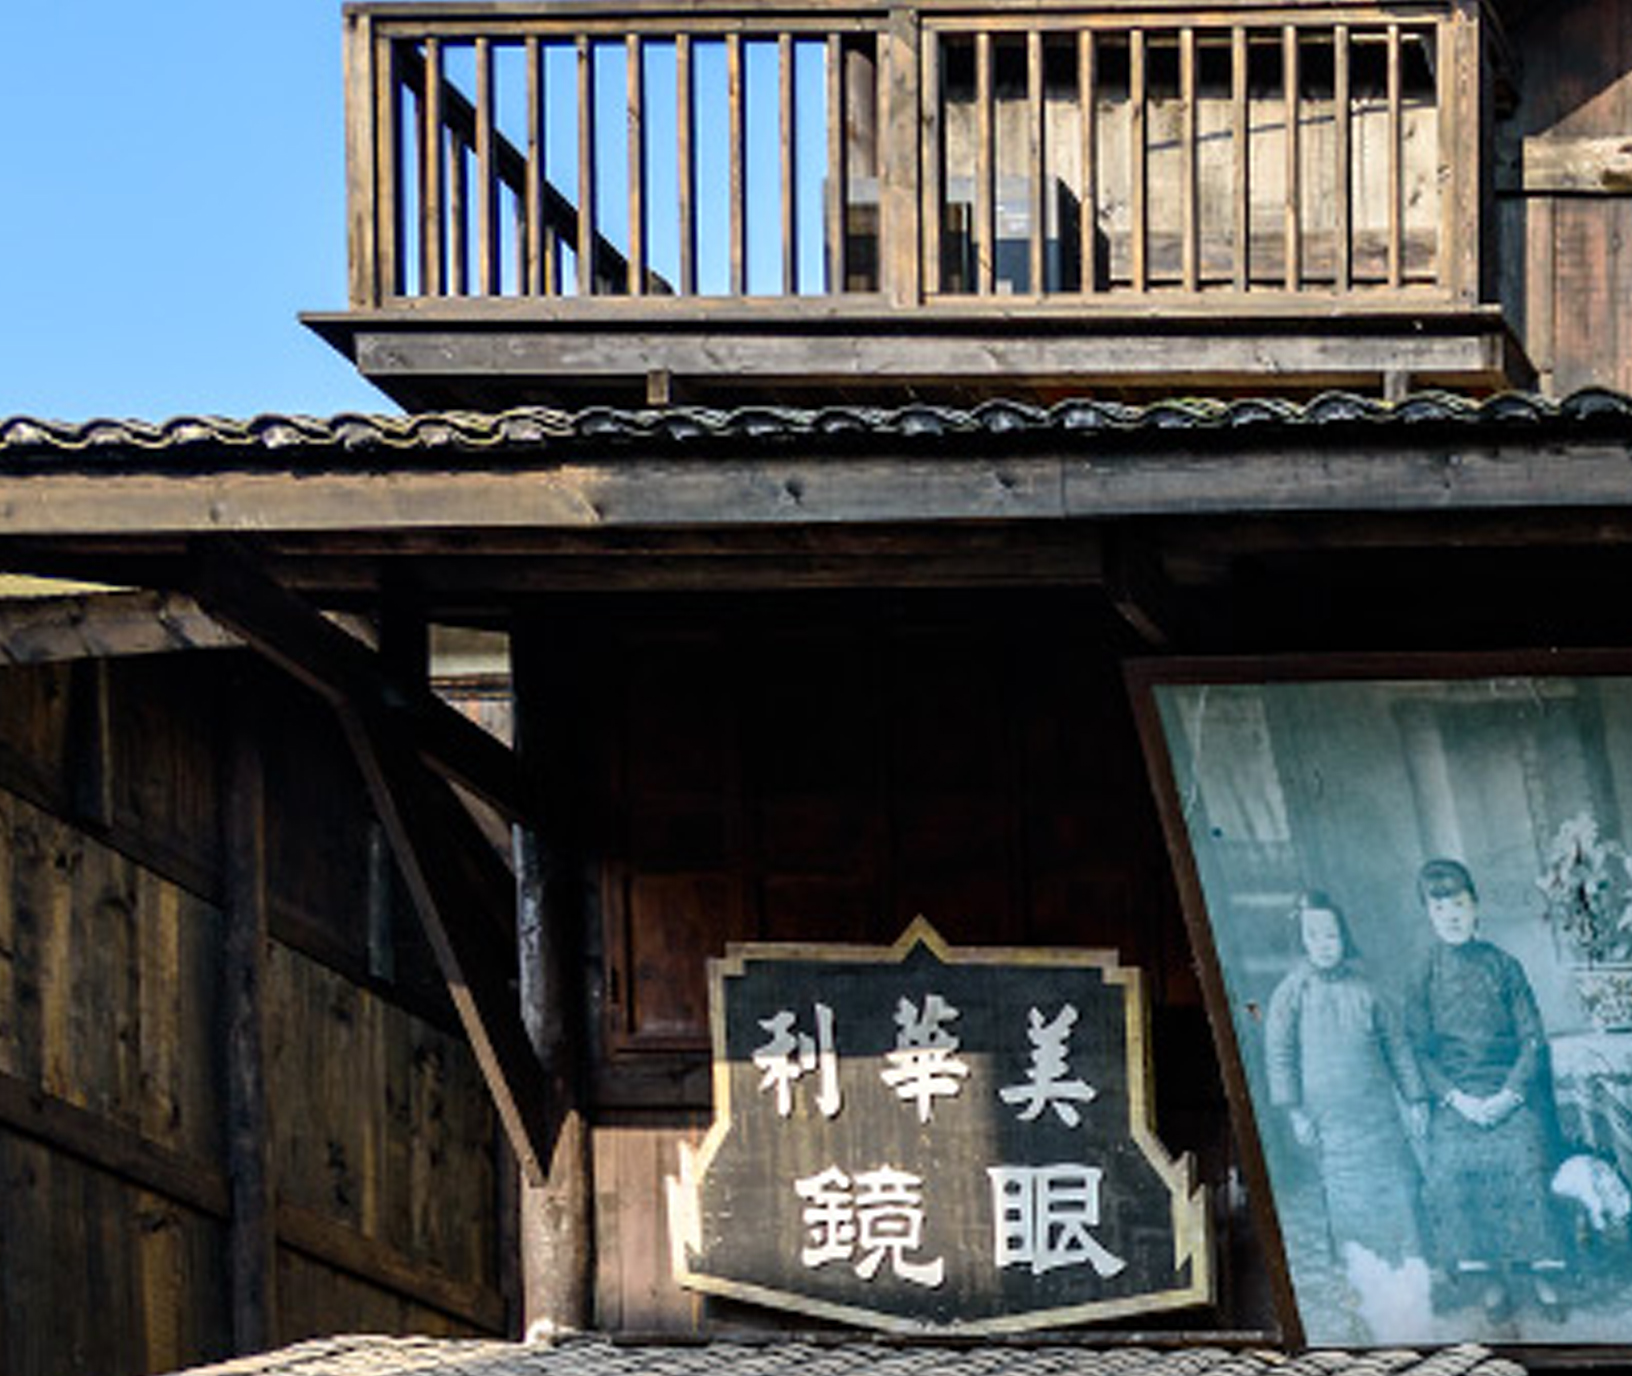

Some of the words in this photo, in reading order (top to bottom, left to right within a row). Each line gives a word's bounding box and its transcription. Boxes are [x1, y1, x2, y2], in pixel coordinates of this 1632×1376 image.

[752, 993, 1098, 1128] 美華利
[793, 1163, 1127, 1288] 眼鏡
